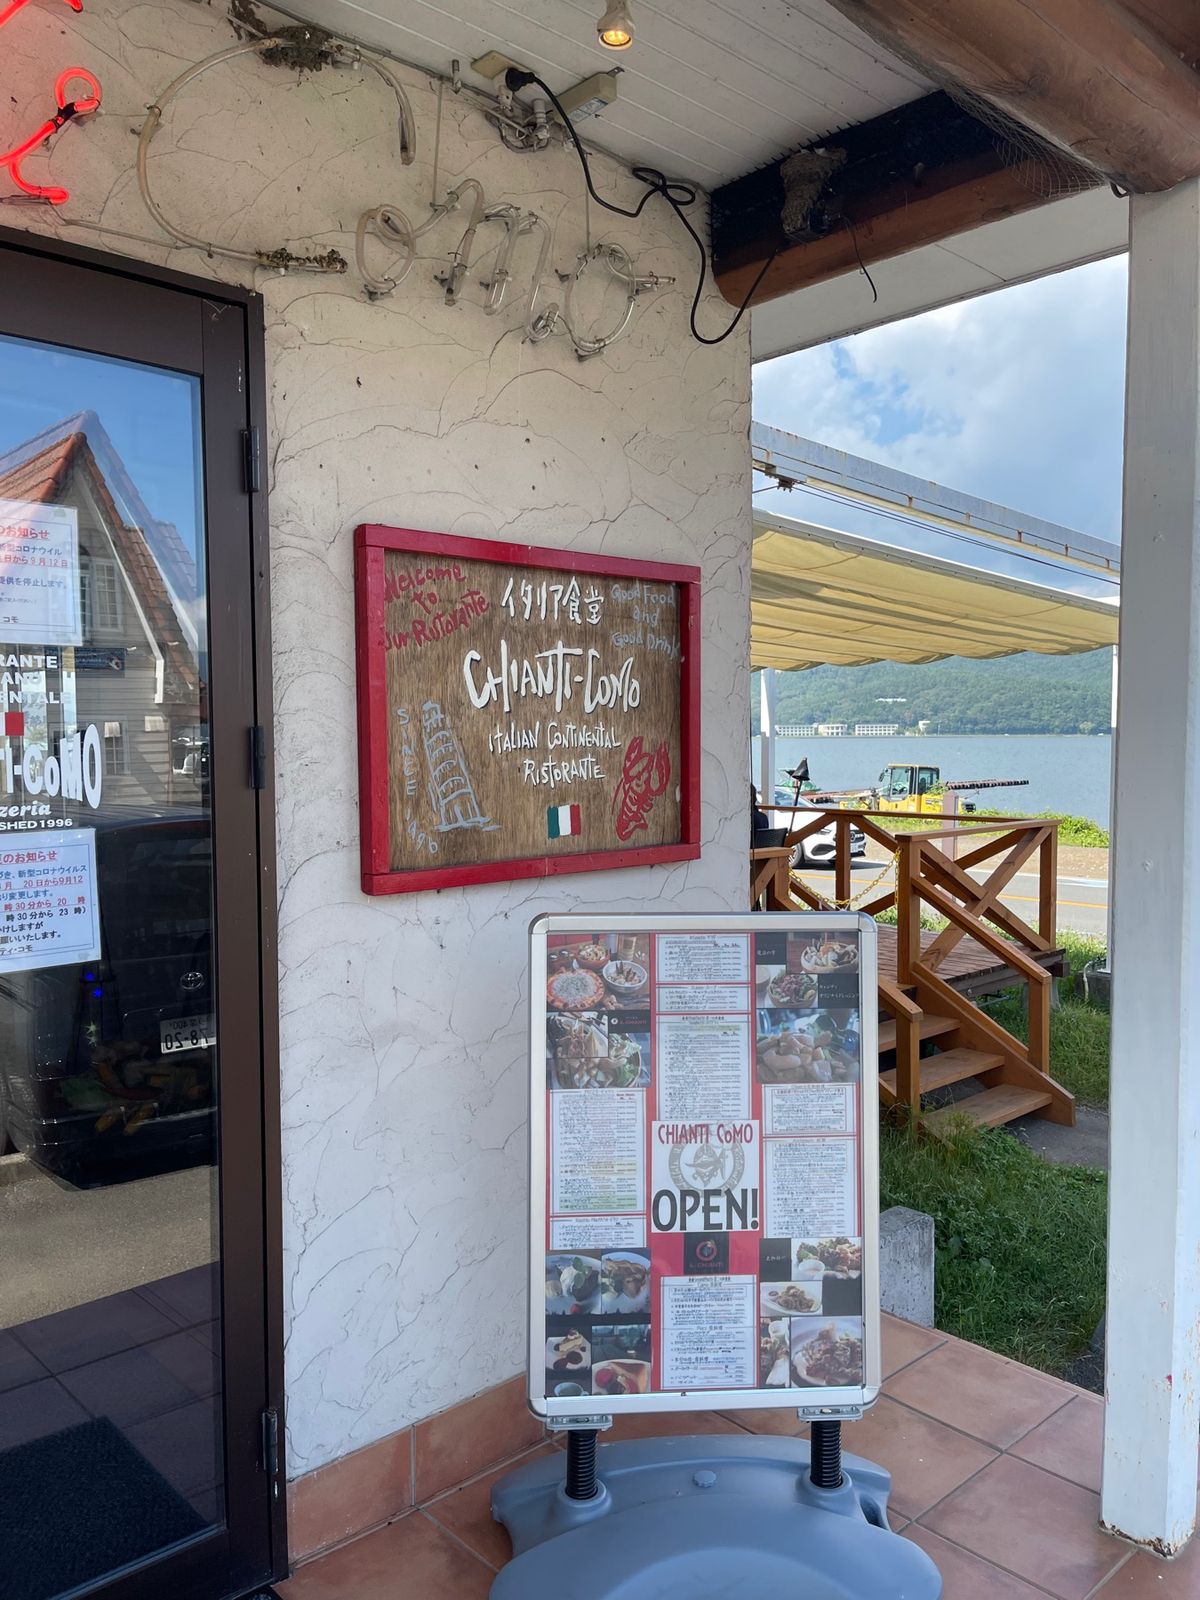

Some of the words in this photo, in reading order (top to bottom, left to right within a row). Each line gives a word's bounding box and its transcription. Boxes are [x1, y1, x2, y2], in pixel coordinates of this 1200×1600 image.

[384, 563, 466, 603] Welcome
[501, 575, 604, 625] イタリア食堂
[488, 721, 540, 754] ITALIAN
[0, 820, 38, 831] SHED
[39, 818, 73, 829] 1996
[0, 850, 57, 864] のお知らせ
[0, 889, 53, 902] り変更します。
[0, 921, 44, 933] けしますが
[658, 1123, 710, 1145] CHIANTI
[652, 1188, 759, 1232] OPEN!
